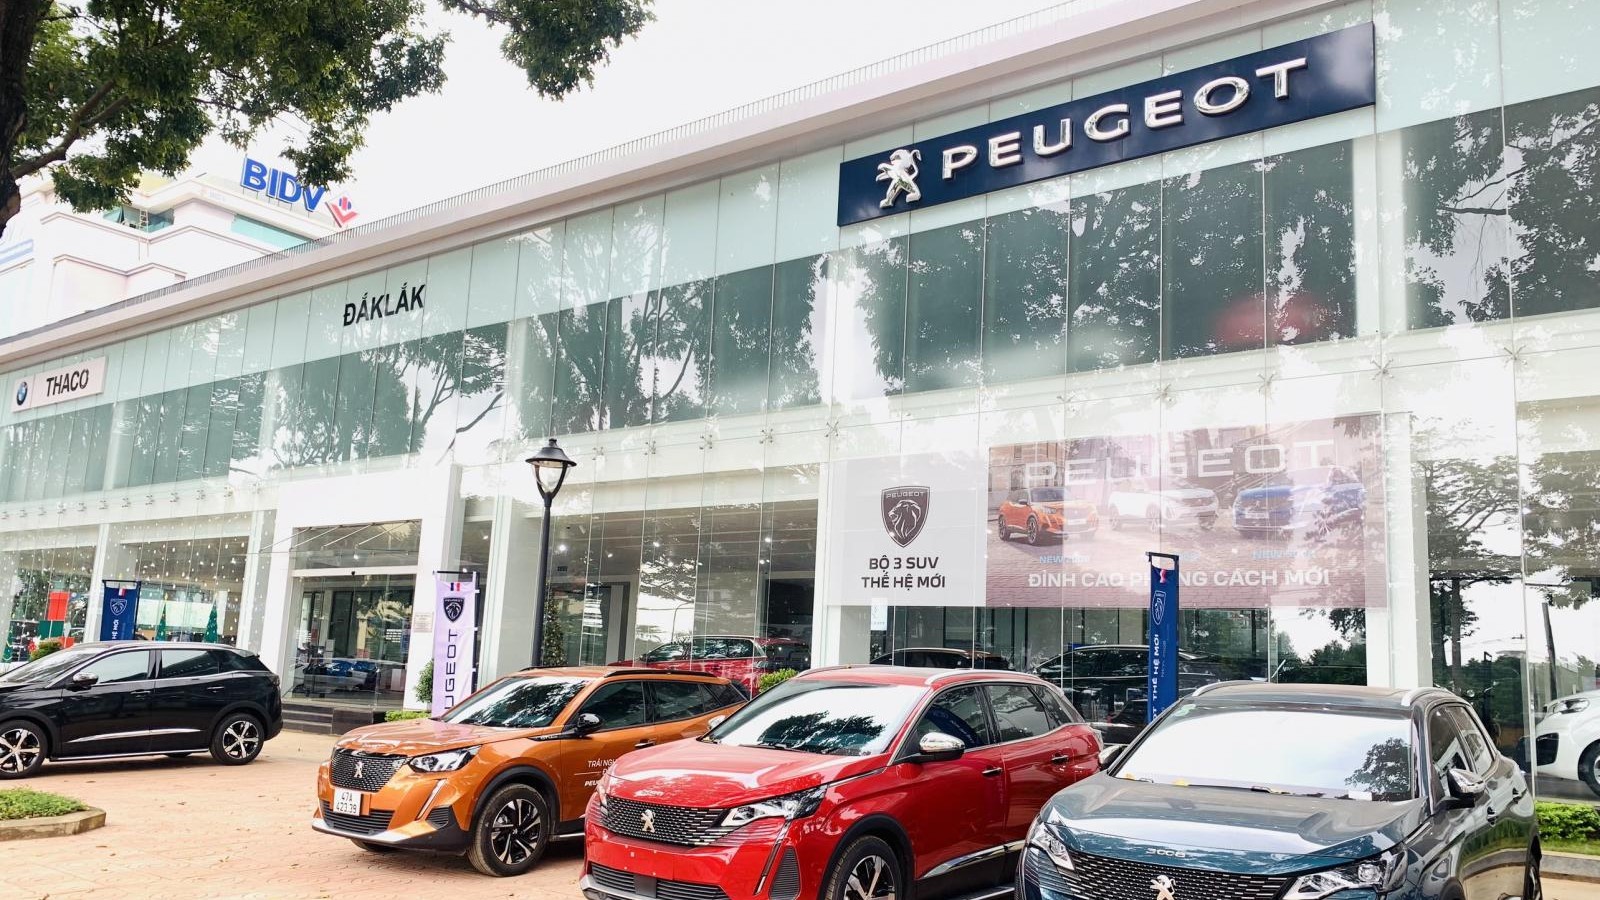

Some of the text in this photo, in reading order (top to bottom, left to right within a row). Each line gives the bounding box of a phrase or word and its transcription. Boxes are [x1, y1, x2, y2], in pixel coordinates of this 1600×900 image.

[943, 57, 1307, 180] PEUGEOT
[241, 157, 327, 211] BIDV
[343, 282, 426, 327] ĐẮKLẮK
[46, 369, 90, 397] THACO
[1025, 438, 1335, 488] PEUGEOT
[885, 490, 925, 499] PEUGEOT
[869, 555, 939, 573] BỘ 3 SUV
[1081, 572, 1122, 587] CAO
[1130, 570, 1208, 587] PNG
[1213, 568, 1277, 586] CÁCH
[861, 571, 946, 591] THẾ HỆ MỚI
[444, 628, 458, 710] UGEOT
[1145, 848, 1186, 858] 3008
